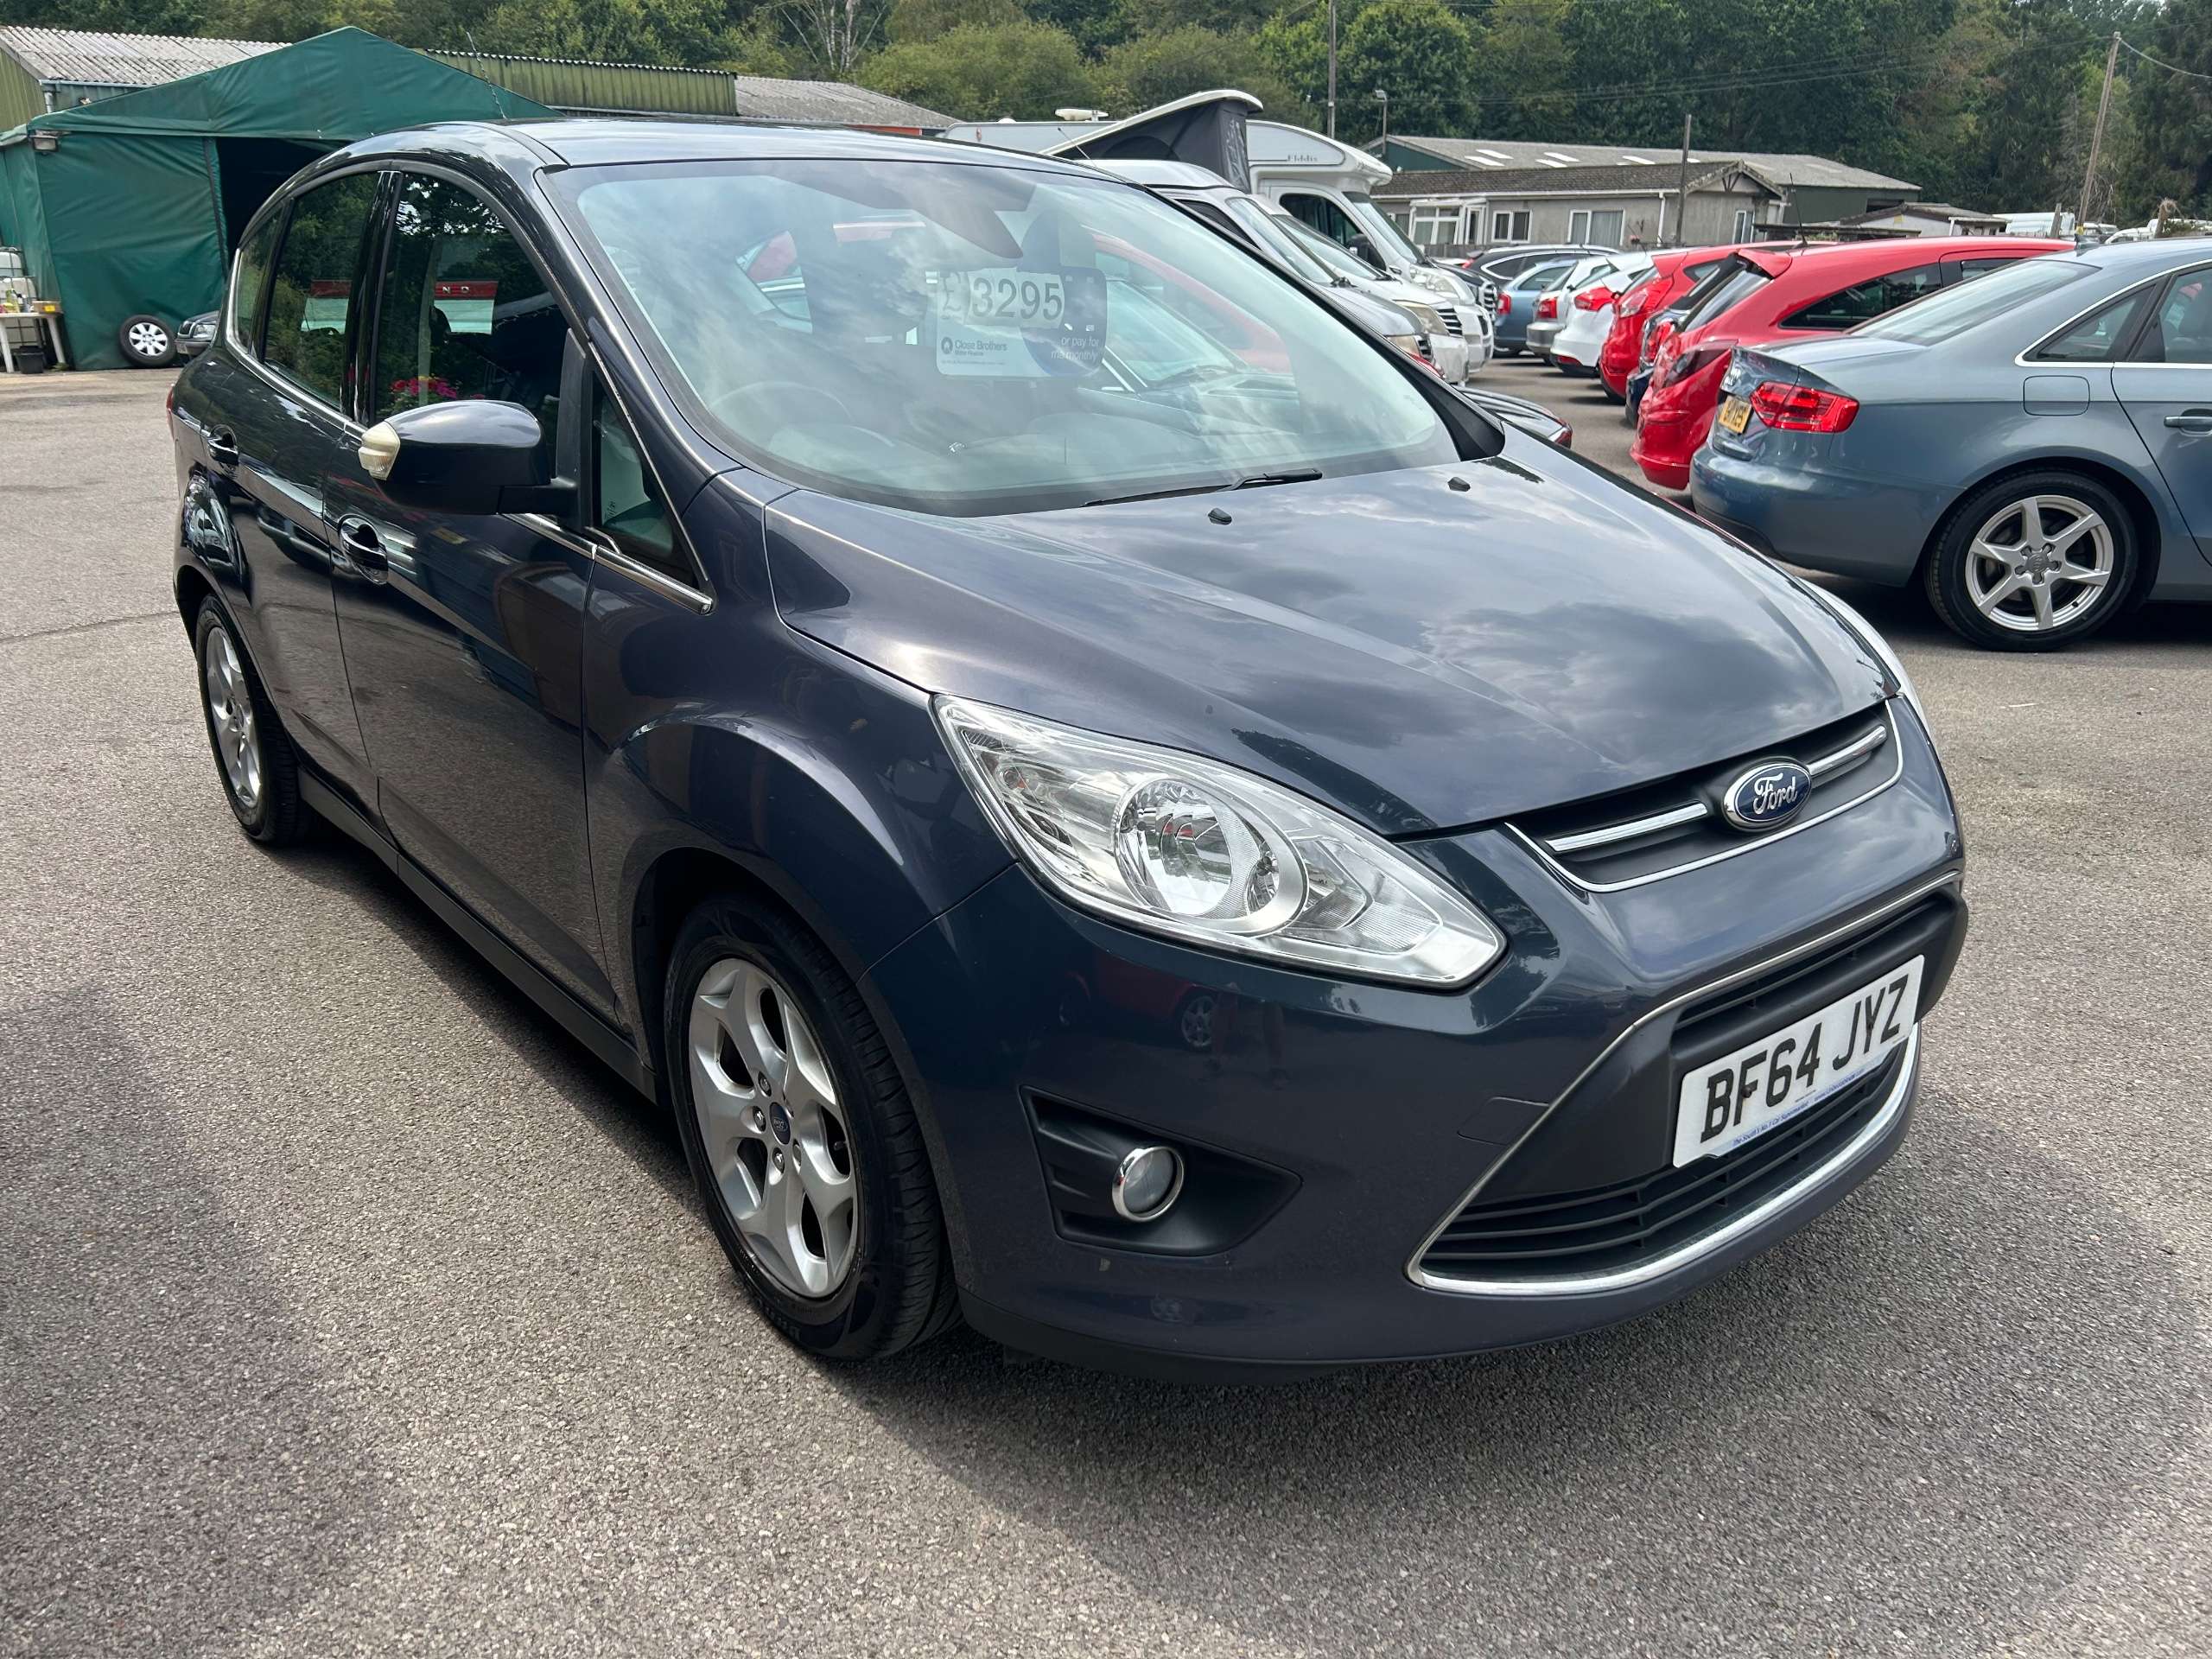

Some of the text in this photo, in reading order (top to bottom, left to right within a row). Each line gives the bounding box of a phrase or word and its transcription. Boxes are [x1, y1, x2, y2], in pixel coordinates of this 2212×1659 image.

[954, 340, 1007, 351] Close Brothers
[1071, 338, 1087, 349] pay
[1753, 772, 1797, 815] Ford
[1700, 1022, 1822, 1143] BF64
[1833, 974, 1909, 1071] JYZ
